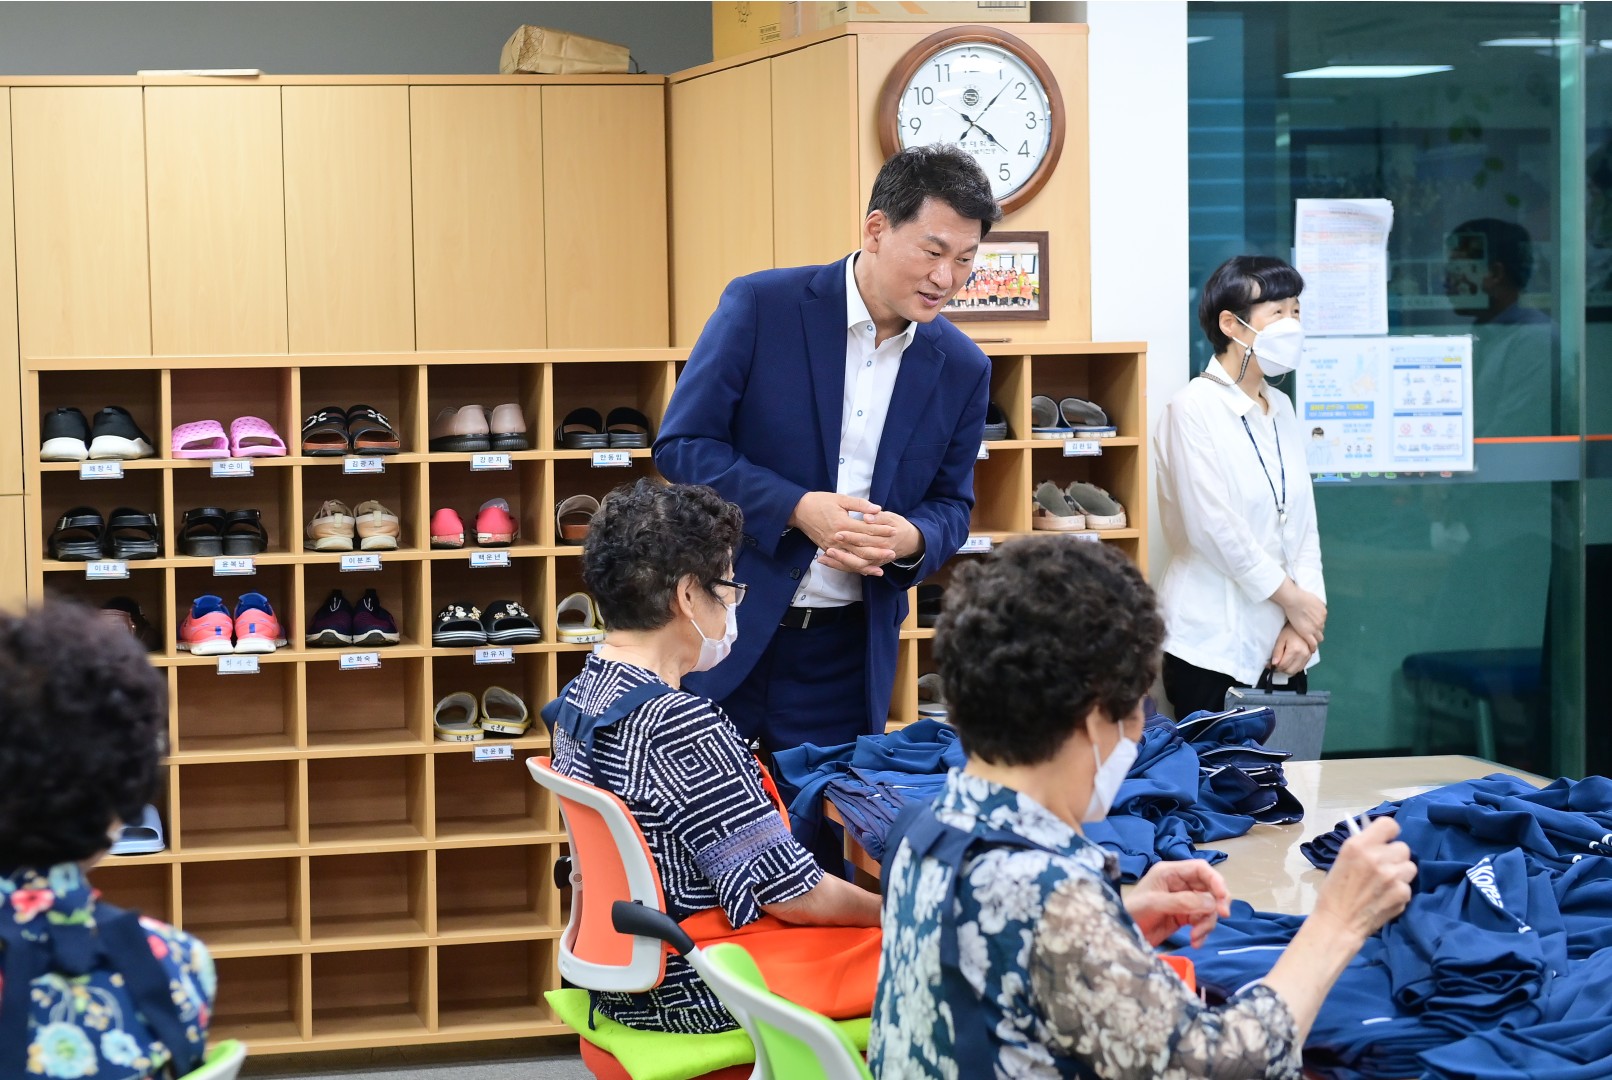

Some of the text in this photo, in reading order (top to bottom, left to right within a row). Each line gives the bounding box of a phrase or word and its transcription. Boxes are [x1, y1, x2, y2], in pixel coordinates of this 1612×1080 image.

[935, 64, 951, 82] 11
[913, 86, 934, 105] 10
[1015, 82, 1027, 100] 2
[909, 117, 922, 135] 9
[1025, 112, 1037, 129] 3
[1017, 140, 1031, 158] 4
[998, 163, 1011, 181] 5
